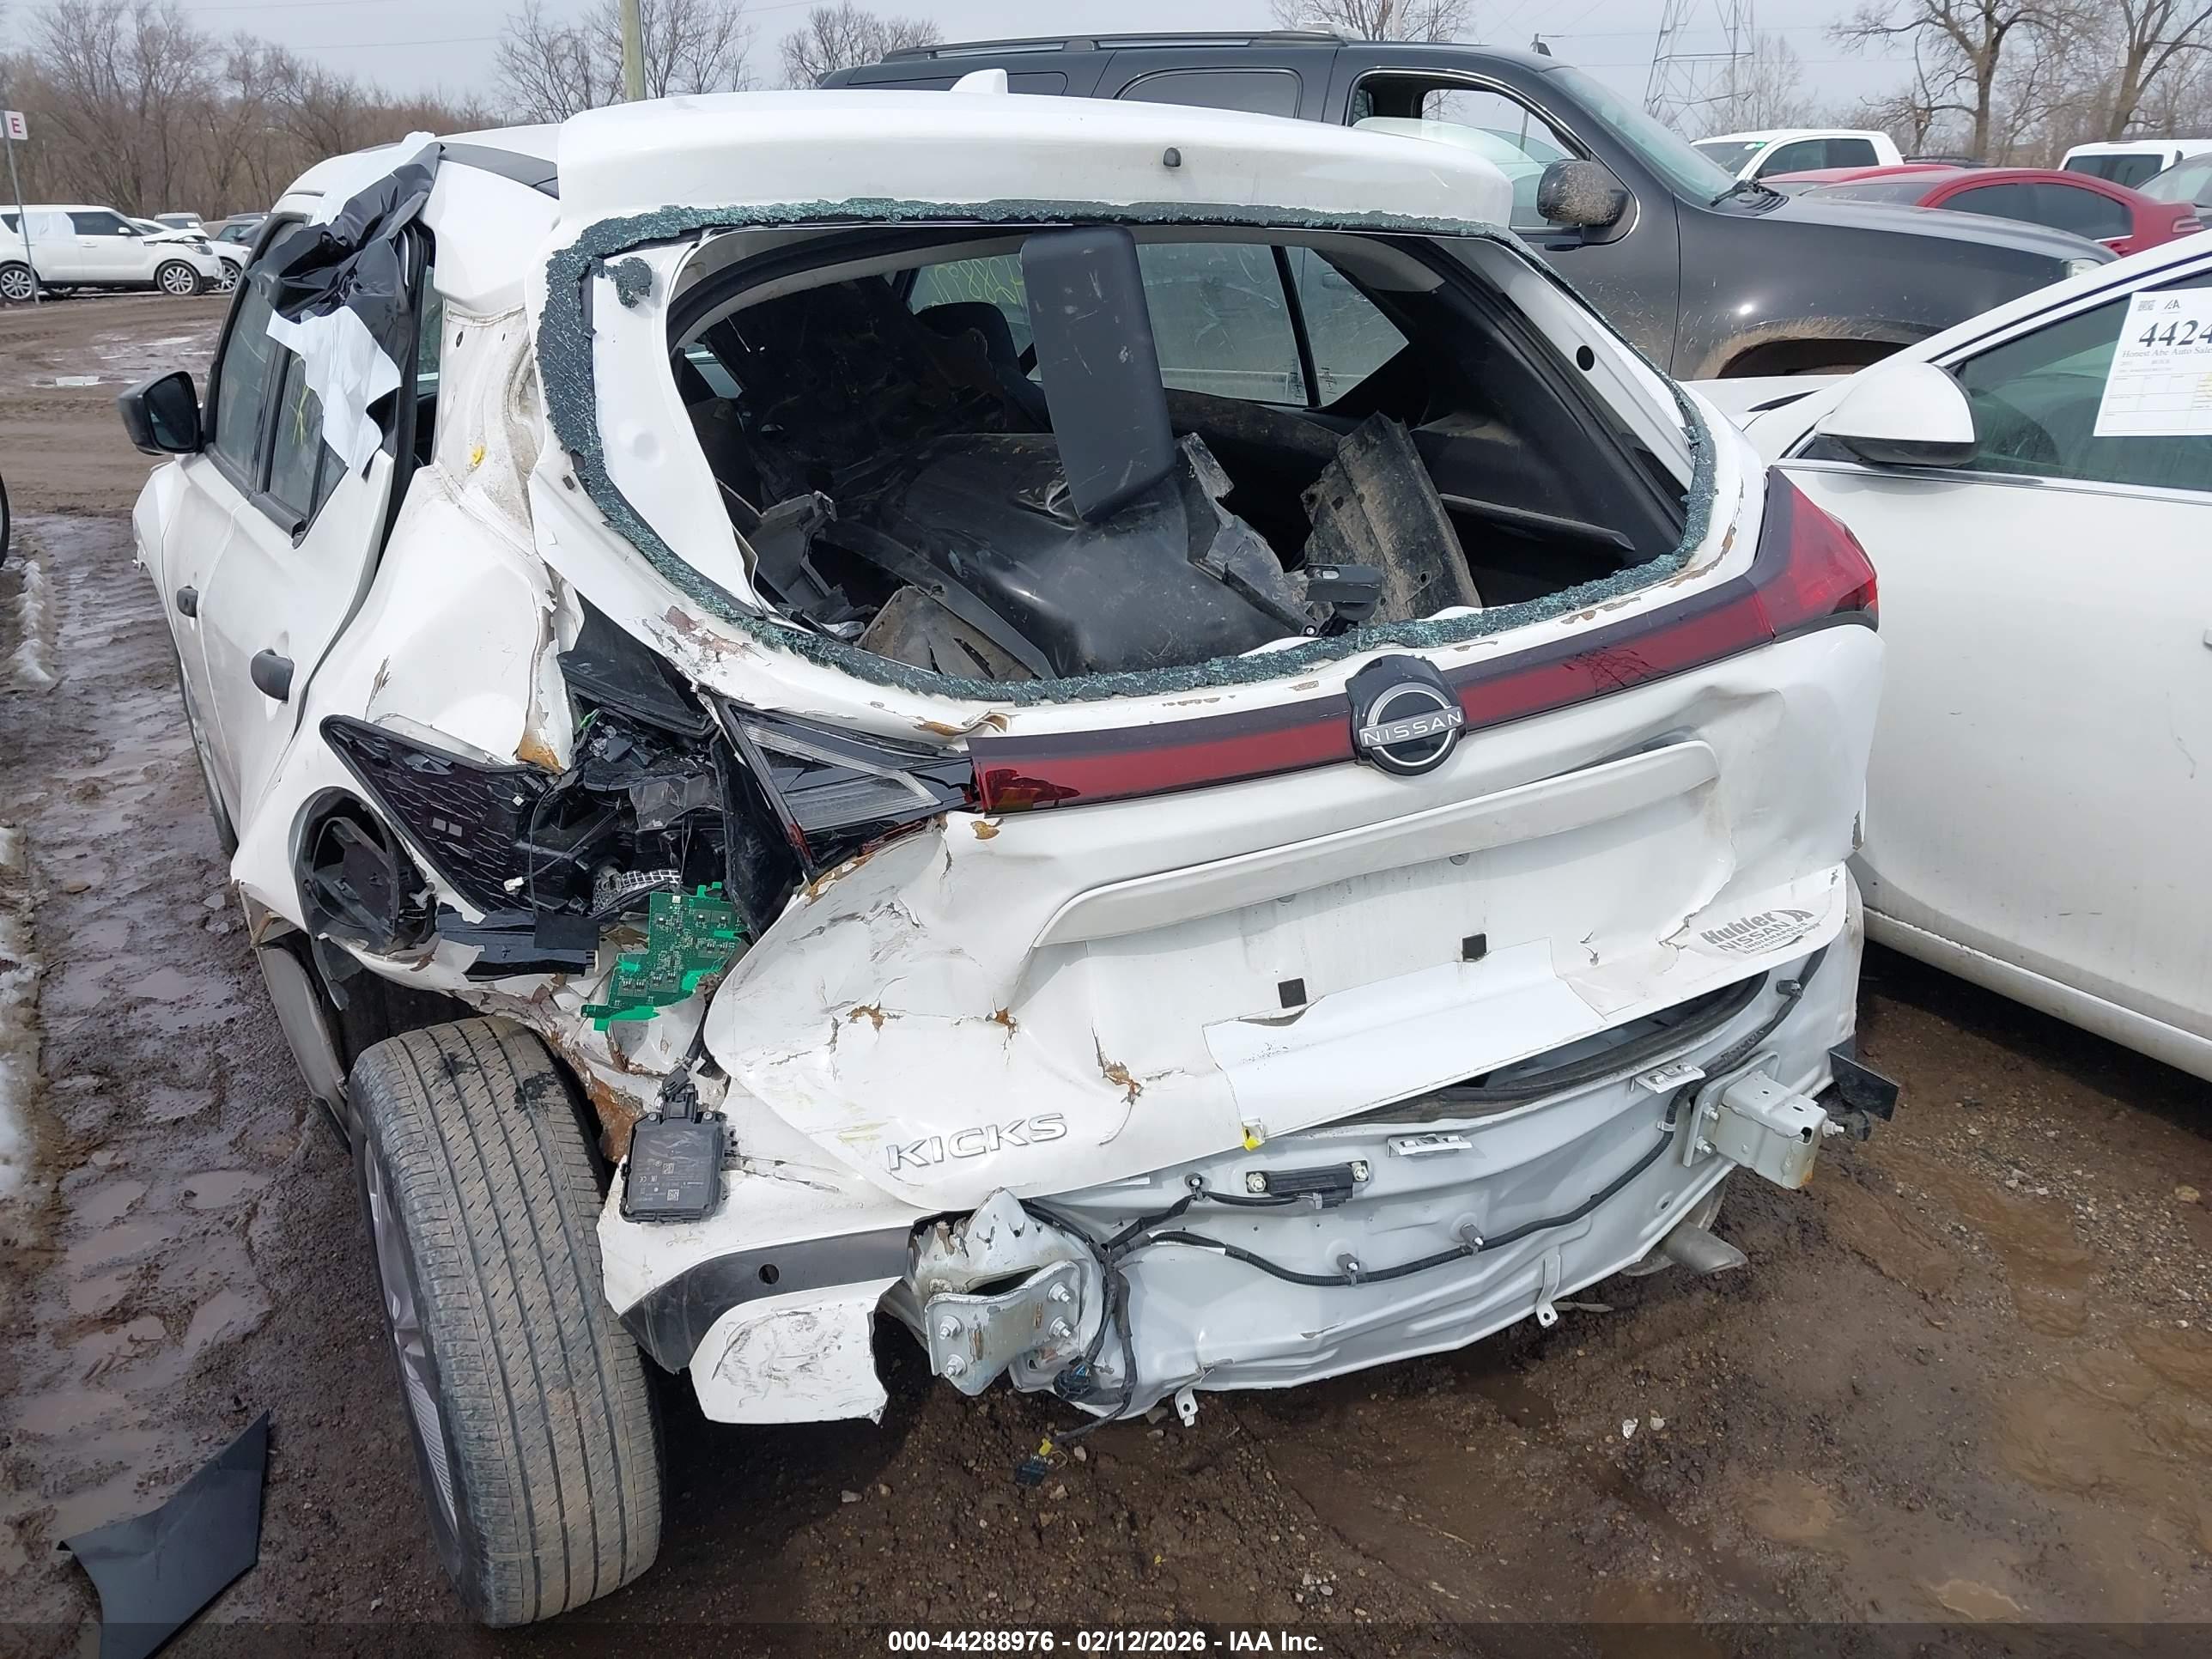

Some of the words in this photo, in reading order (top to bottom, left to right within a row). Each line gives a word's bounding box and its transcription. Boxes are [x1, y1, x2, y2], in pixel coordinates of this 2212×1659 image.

[10, 117, 22, 134] E
[1364, 710, 1462, 745] NISSAN
[1699, 911, 1778, 945] Hubler
[1717, 921, 1791, 952] NISSAN
[1744, 922, 1808, 950] INDIANAPOLIS
[885, 1112, 1067, 1171] KICKS
